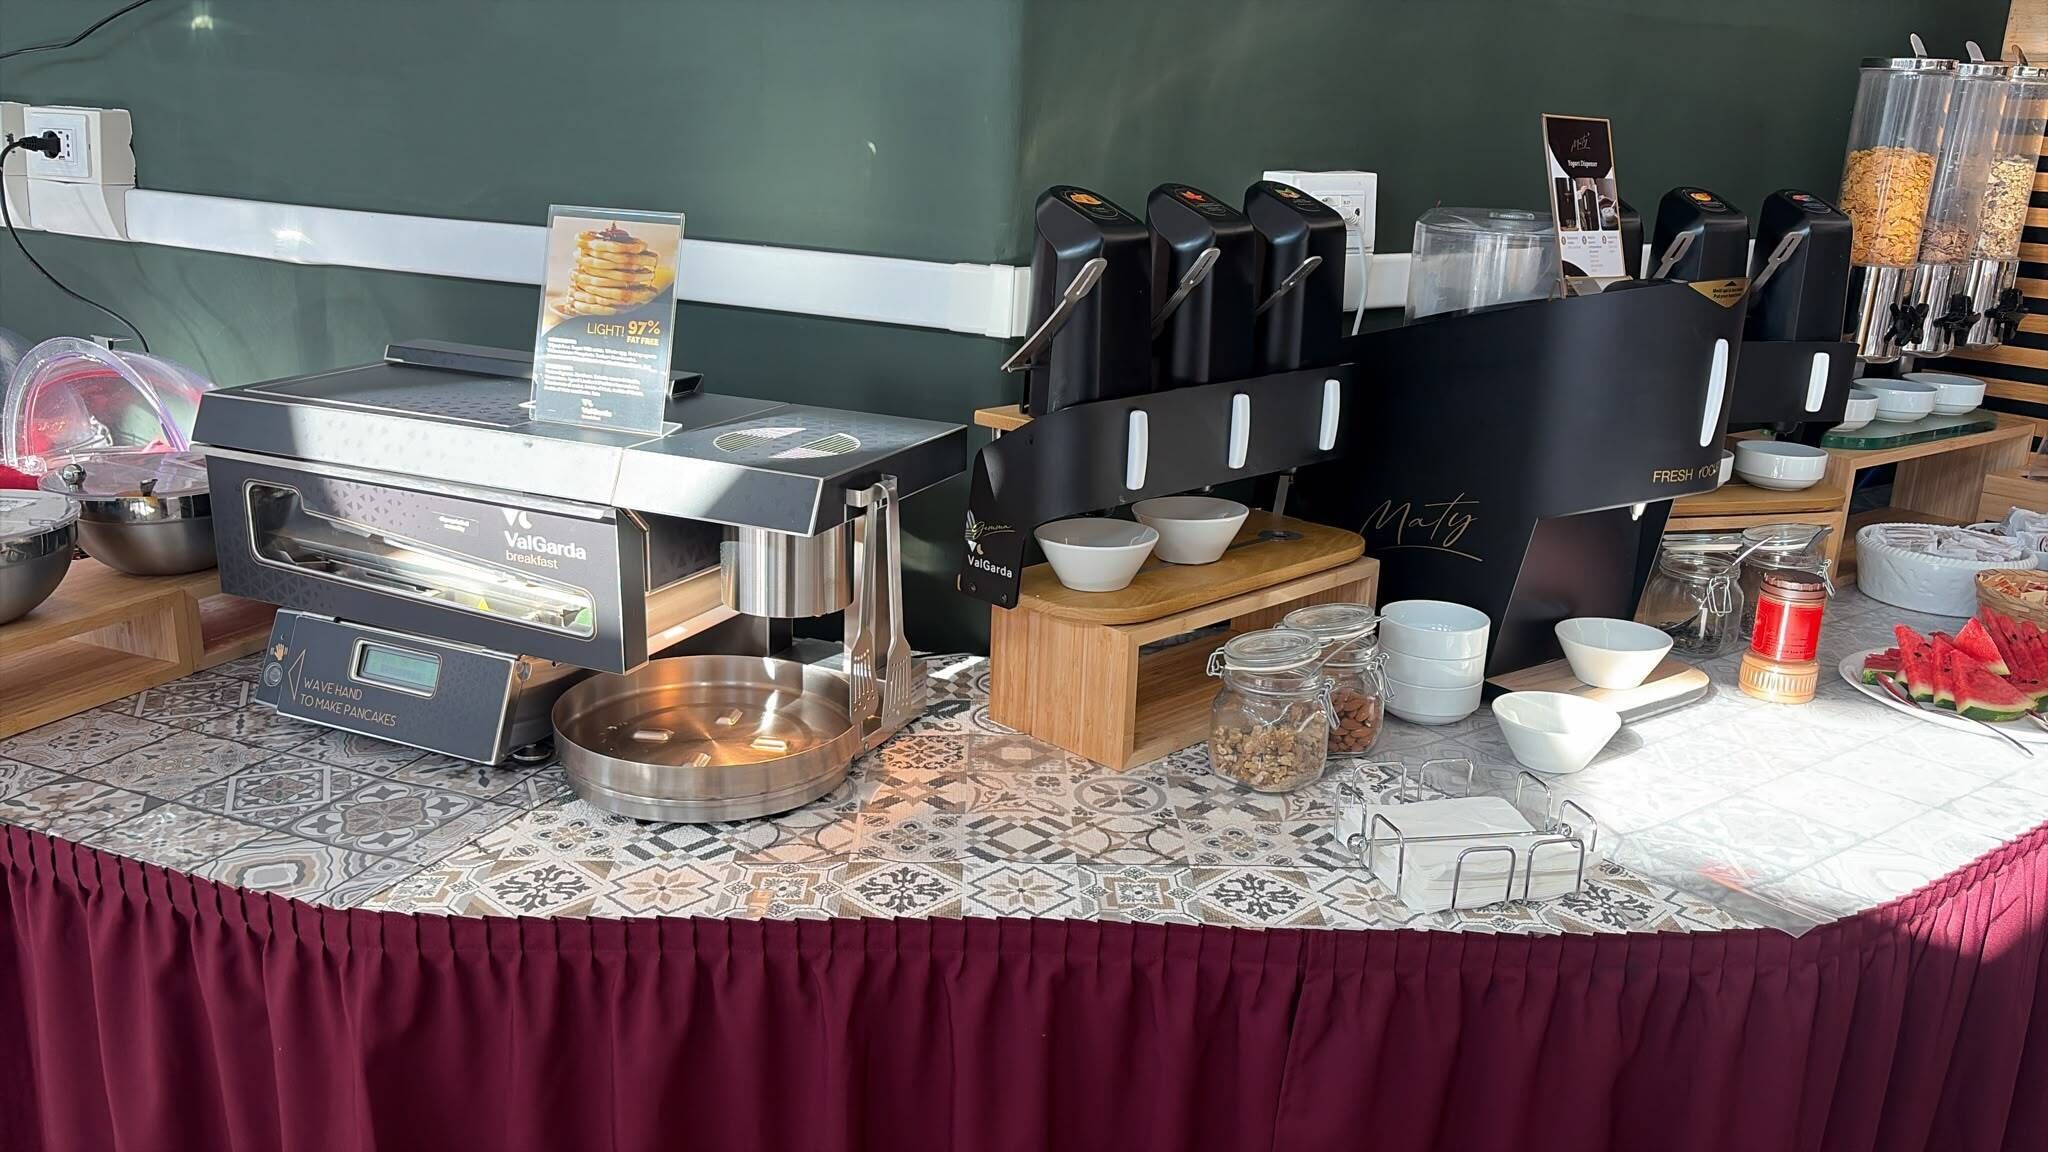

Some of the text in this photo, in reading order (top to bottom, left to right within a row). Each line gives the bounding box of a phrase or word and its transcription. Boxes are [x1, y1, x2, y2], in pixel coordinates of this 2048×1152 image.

[586, 319, 661, 337] LIGHT! 97%
[626, 336, 660, 346] FAT FREE
[1652, 468, 1694, 484] FRESH
[1359, 492, 1480, 549] Maty
[503, 530, 587, 561] ValGarda
[505, 549, 559, 569] breakfast
[967, 554, 1013, 579] ValGarda
[303, 676, 363, 701] WAVE HAND
[299, 693, 397, 727] TO MAKE PANCAKES
